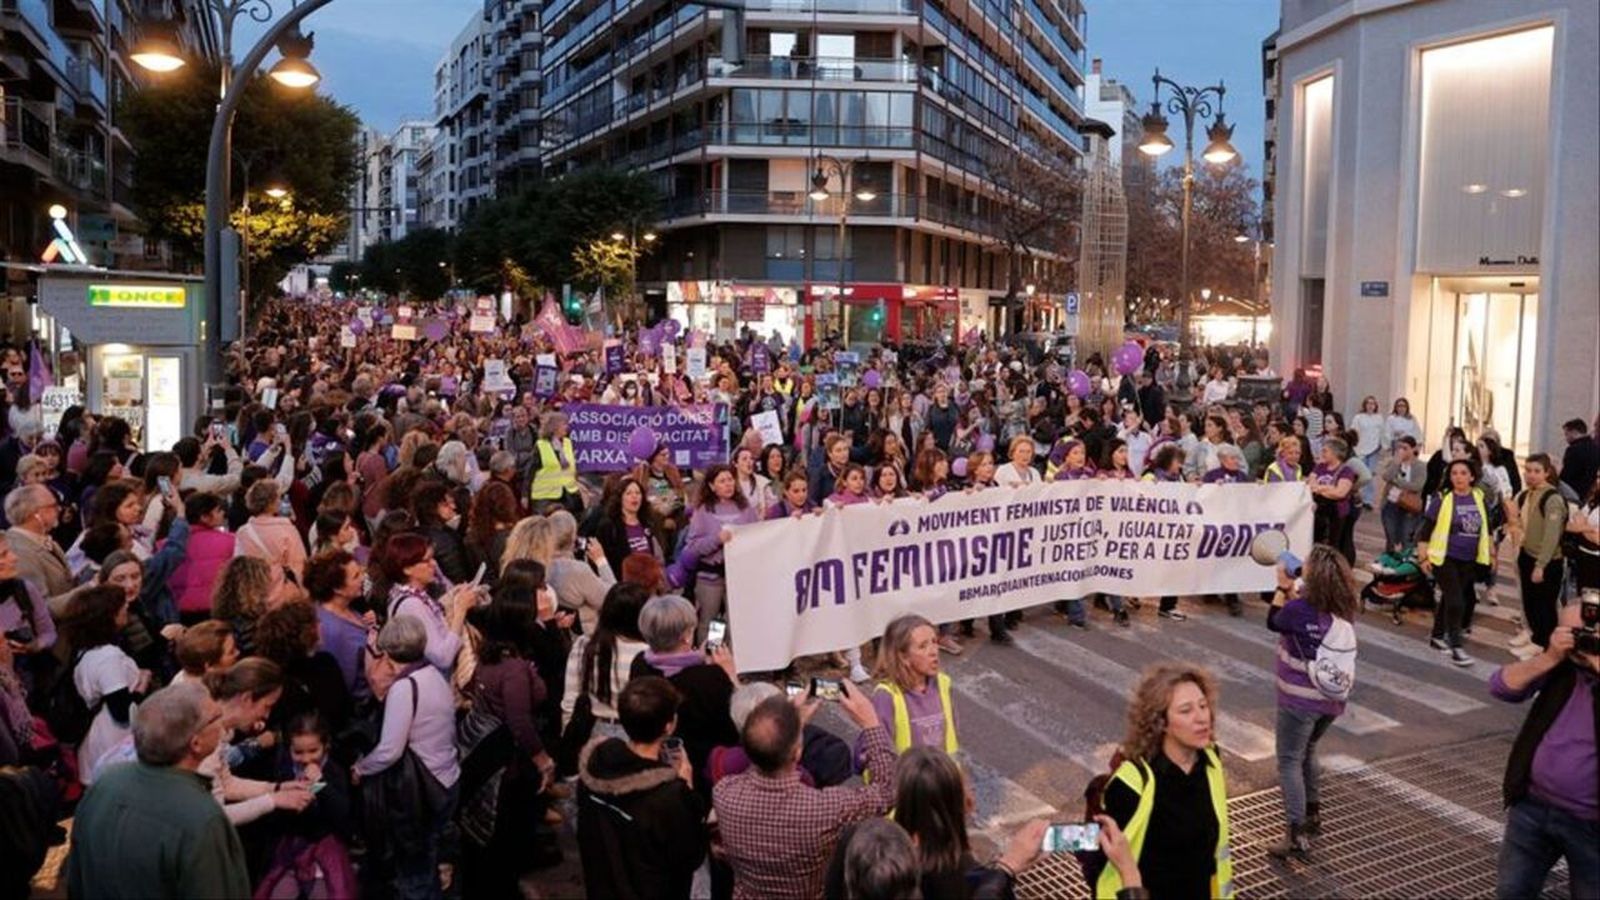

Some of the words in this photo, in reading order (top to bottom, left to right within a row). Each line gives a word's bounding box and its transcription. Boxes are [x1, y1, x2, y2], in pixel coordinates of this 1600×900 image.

[118, 289, 178, 303] ONCE
[568, 411, 663, 428] ASSOCIACIÓ
[667, 412, 714, 426] DONES
[569, 430, 602, 443] AMB
[574, 449, 628, 464] ARXA
[917, 506, 1001, 533] MOVIMENT
[1006, 498, 1081, 521] FEMINISTA
[1086, 496, 1104, 512] DE
[1111, 497, 1180, 515] VALÈNCIA
[1118, 521, 1195, 541] IGUALTAT
[1196, 523, 1286, 559] DON
[1040, 547, 1046, 565] I
[1051, 539, 1099, 563] DRETS
[1105, 541, 1139, 561] PER
[1143, 542, 1154, 560] A
[1163, 542, 1190, 561] LES
[795, 558, 846, 615] 8M
[852, 527, 1035, 600] FEMINISME
